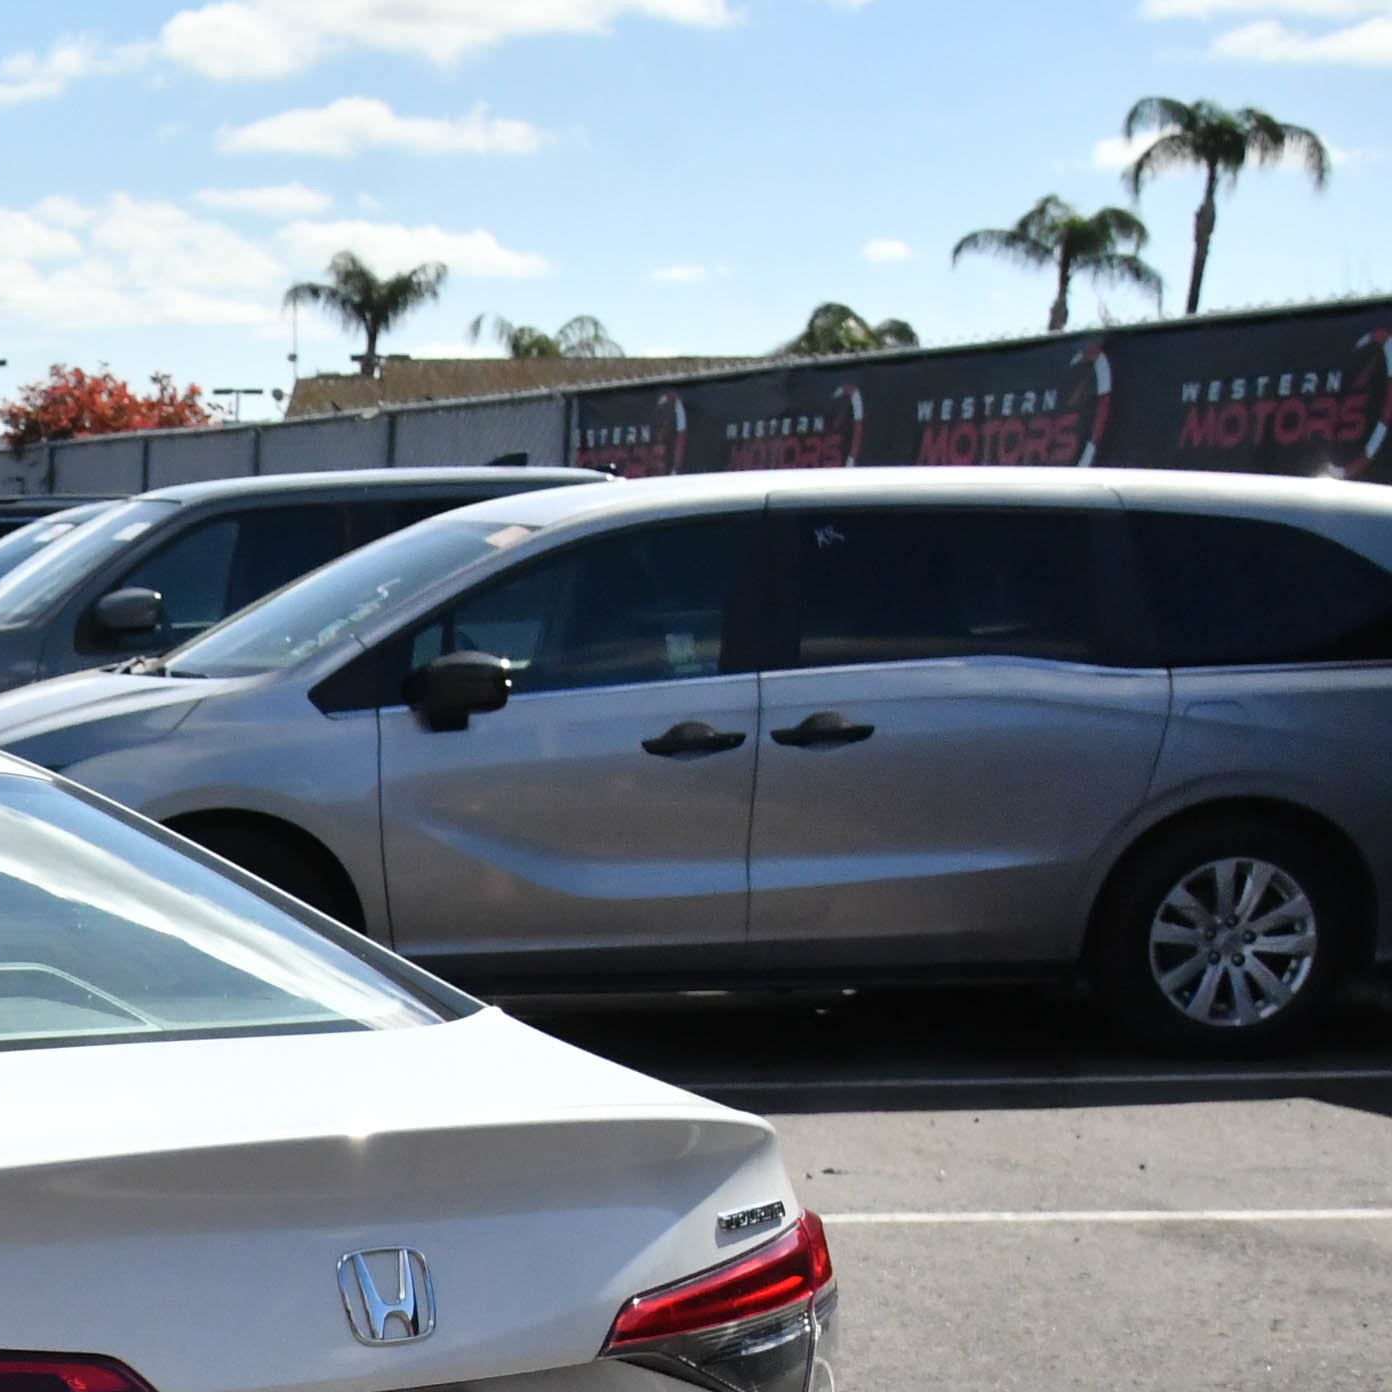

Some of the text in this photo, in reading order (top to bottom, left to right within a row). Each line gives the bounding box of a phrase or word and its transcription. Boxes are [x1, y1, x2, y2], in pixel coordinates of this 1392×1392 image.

[1182, 370, 1343, 402] WESTERN
[917, 389, 1058, 422] WESTERN
[1179, 394, 1369, 450] MOTORS
[725, 416, 824, 440] WESTERN
[918, 412, 1079, 466] MOTORS
